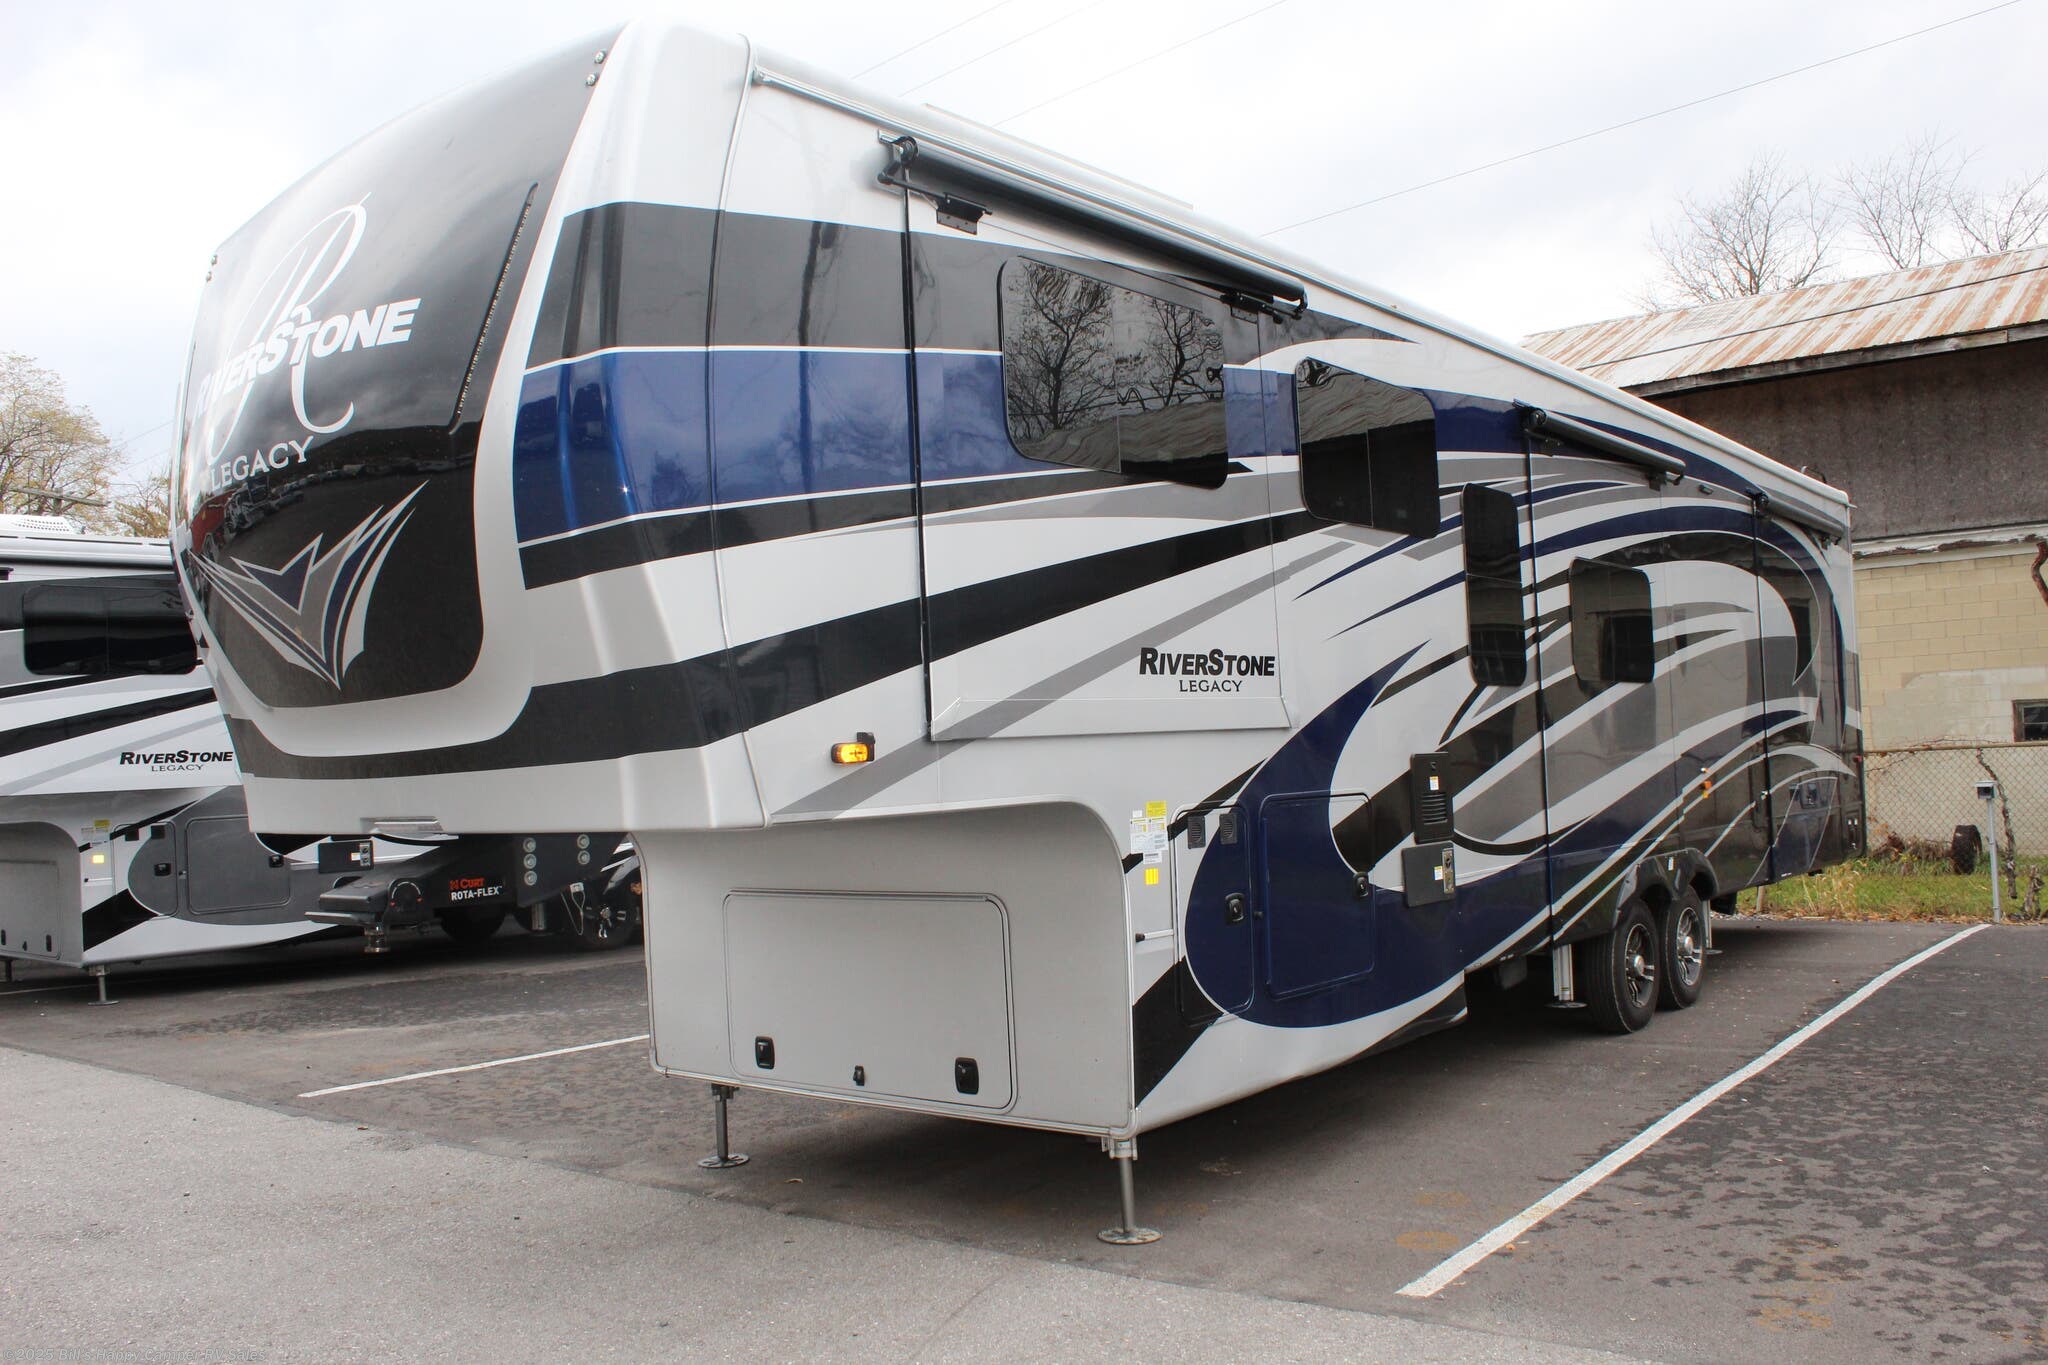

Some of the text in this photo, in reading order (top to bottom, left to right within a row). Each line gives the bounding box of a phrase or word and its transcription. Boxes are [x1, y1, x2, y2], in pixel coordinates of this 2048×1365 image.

[209, 435, 314, 491] LEGACY
[1179, 679, 1243, 692] LEGACY
[151, 764, 204, 772] LEGACY
[460, 877, 485, 889] CURT
